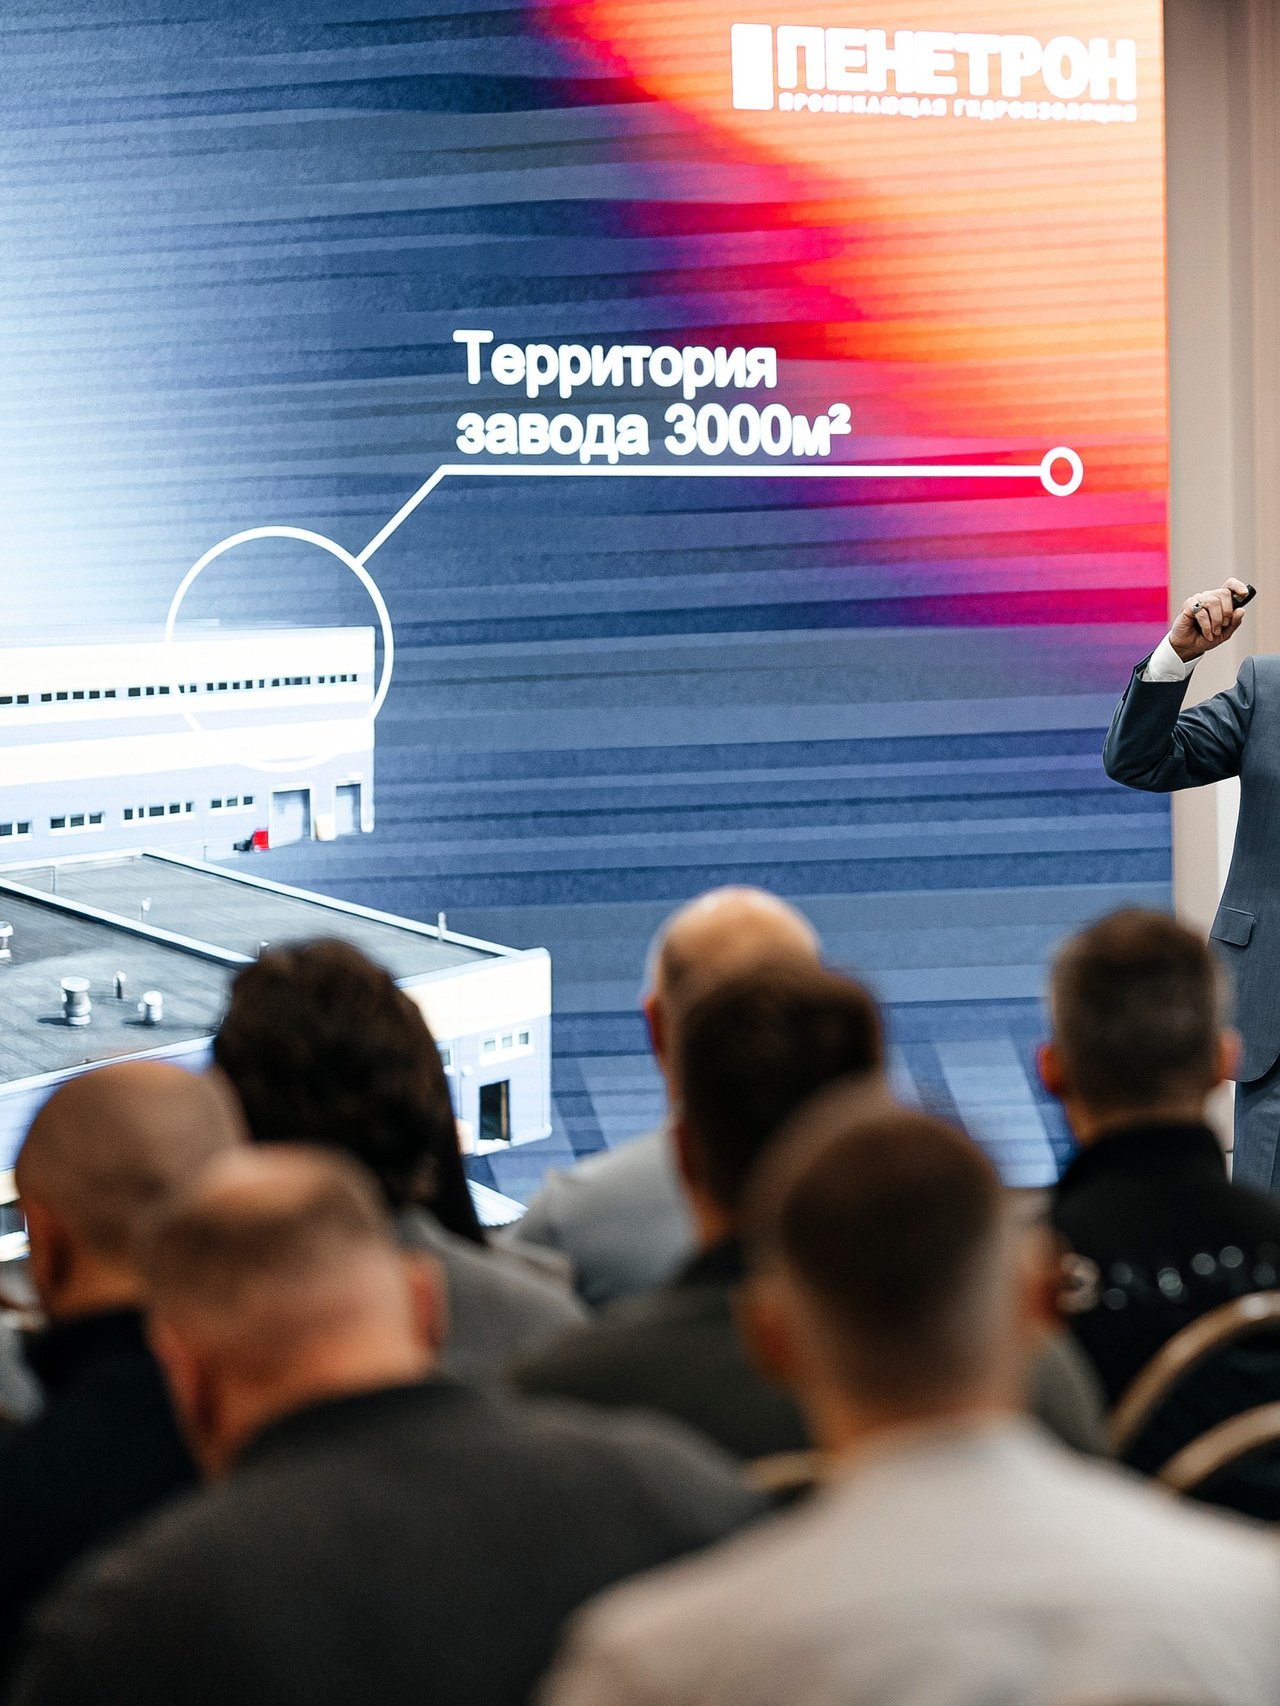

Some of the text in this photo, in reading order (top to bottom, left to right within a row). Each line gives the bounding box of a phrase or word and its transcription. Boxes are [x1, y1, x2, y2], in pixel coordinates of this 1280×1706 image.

[777, 25, 1136, 100] ПЕНЕТРОН
[453, 330, 777, 399] Территория
[456, 412, 650, 464] завода
